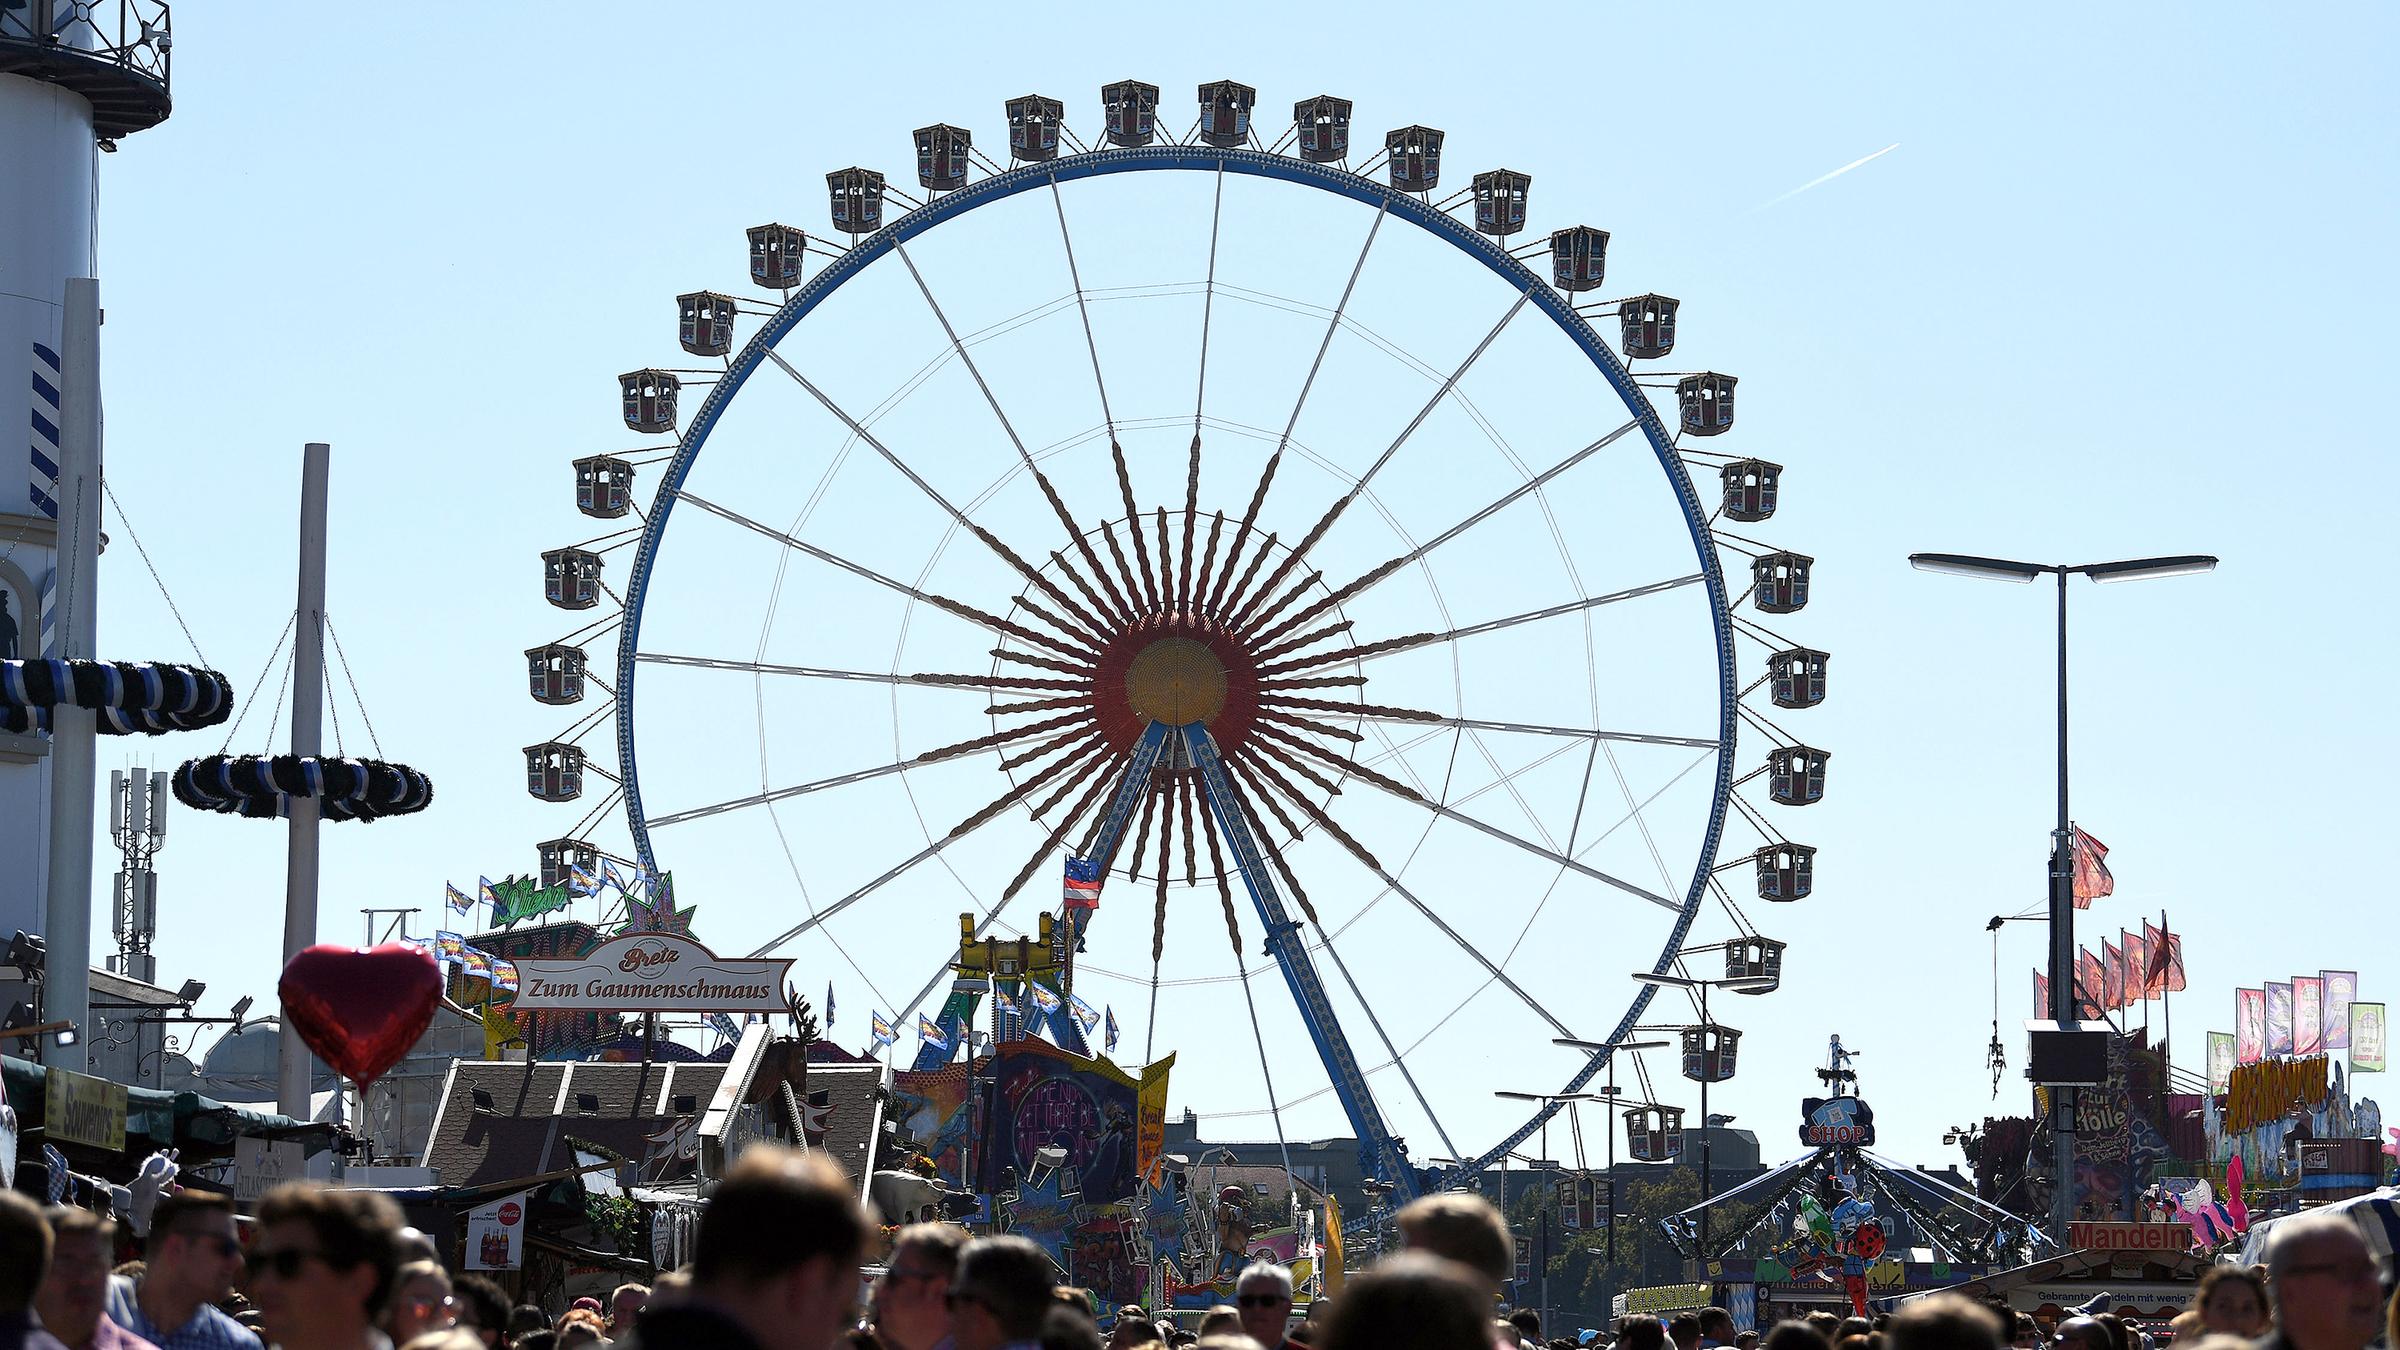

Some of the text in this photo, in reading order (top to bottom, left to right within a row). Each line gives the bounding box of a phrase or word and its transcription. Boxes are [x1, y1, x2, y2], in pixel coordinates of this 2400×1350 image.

[619, 947, 680, 972] Bretz
[528, 978, 770, 999] Zum Gaumenschmaus
[64, 1083, 113, 1143] Souvenirs
[1809, 1125, 1865, 1143] SHOP
[2071, 1223, 2186, 1249] Mandeln
[2038, 1291, 2090, 1301] Gebrannte
[2137, 1293, 2154, 1303] mit
[2156, 1293, 2187, 1304] wenig
